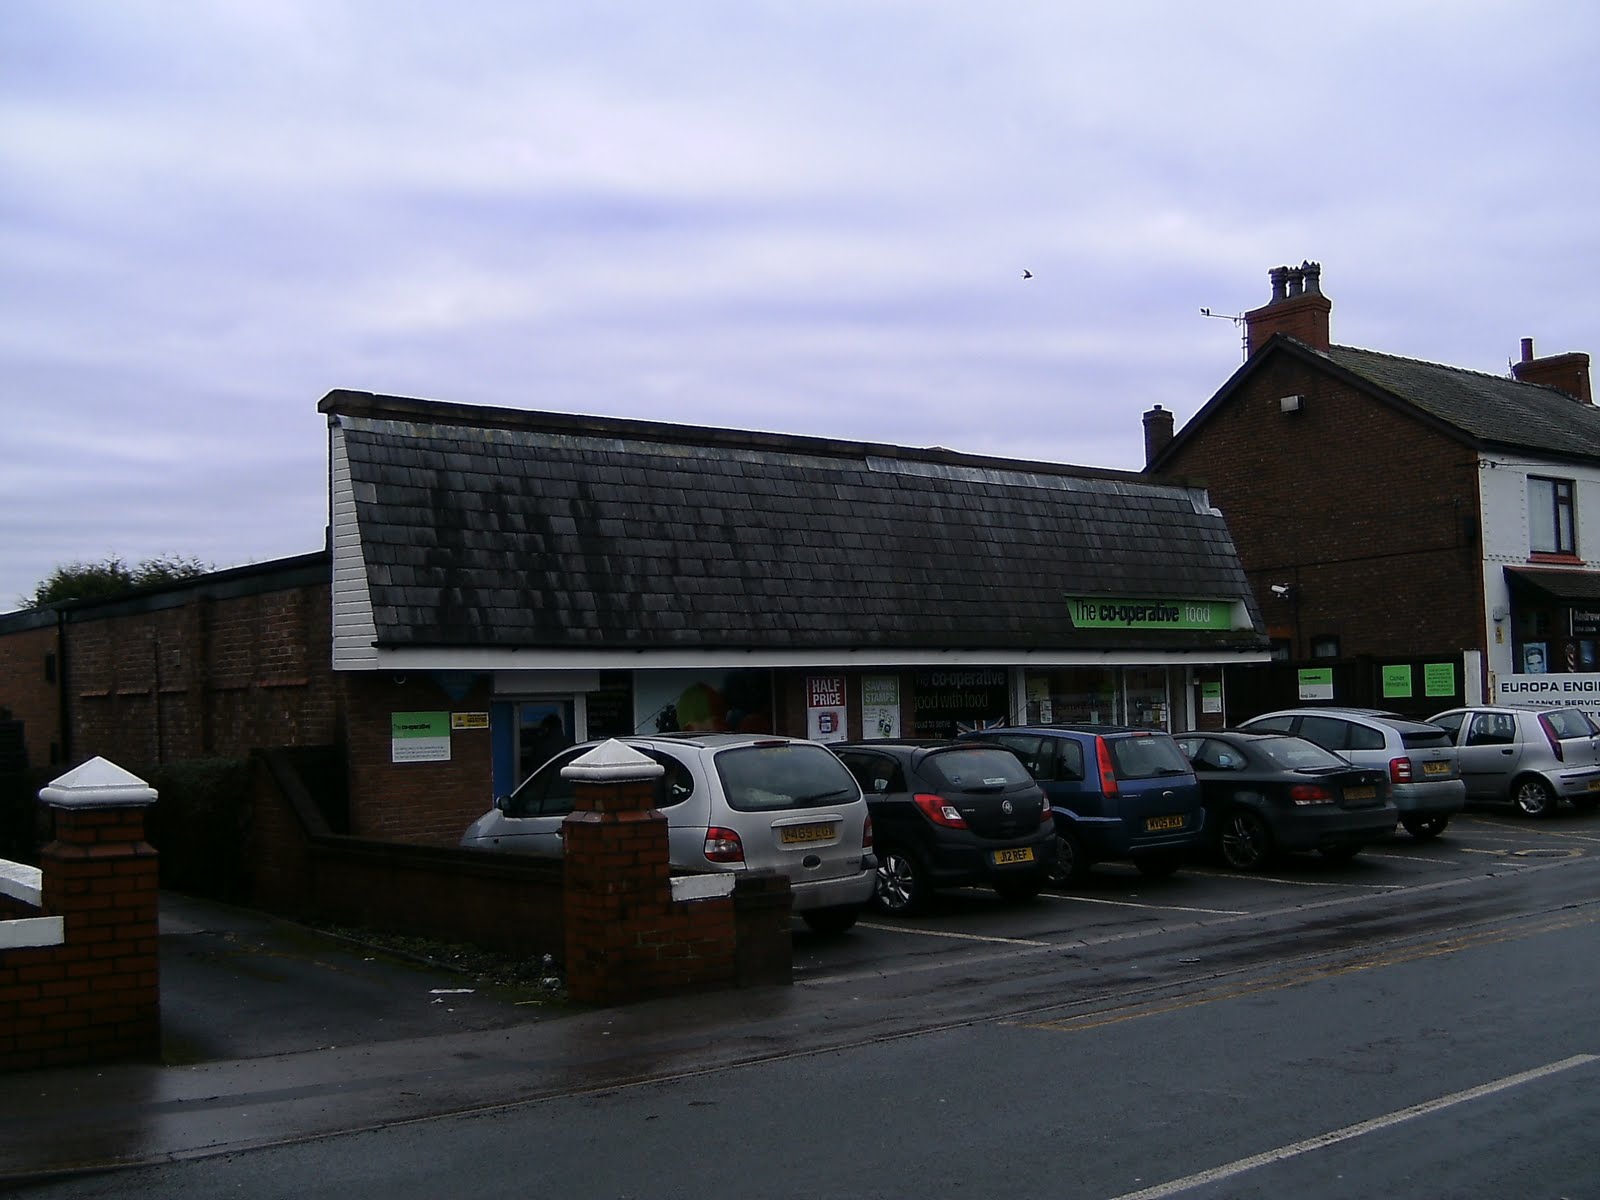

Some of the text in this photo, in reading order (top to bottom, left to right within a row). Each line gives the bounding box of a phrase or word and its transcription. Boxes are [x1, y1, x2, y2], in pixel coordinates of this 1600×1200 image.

[1075, 600, 1210, 626] The co-operative food
[931, 668, 1006, 689] co-operative
[812, 679, 840, 693] HALF
[1501, 681, 1600, 693] EUROPA ENGI
[812, 693, 841, 706] PRICE
[865, 692, 896, 703] STAMPS
[940, 690, 963, 709] with
[964, 689, 989, 708] food
[1013, 850, 1027, 861] REF
